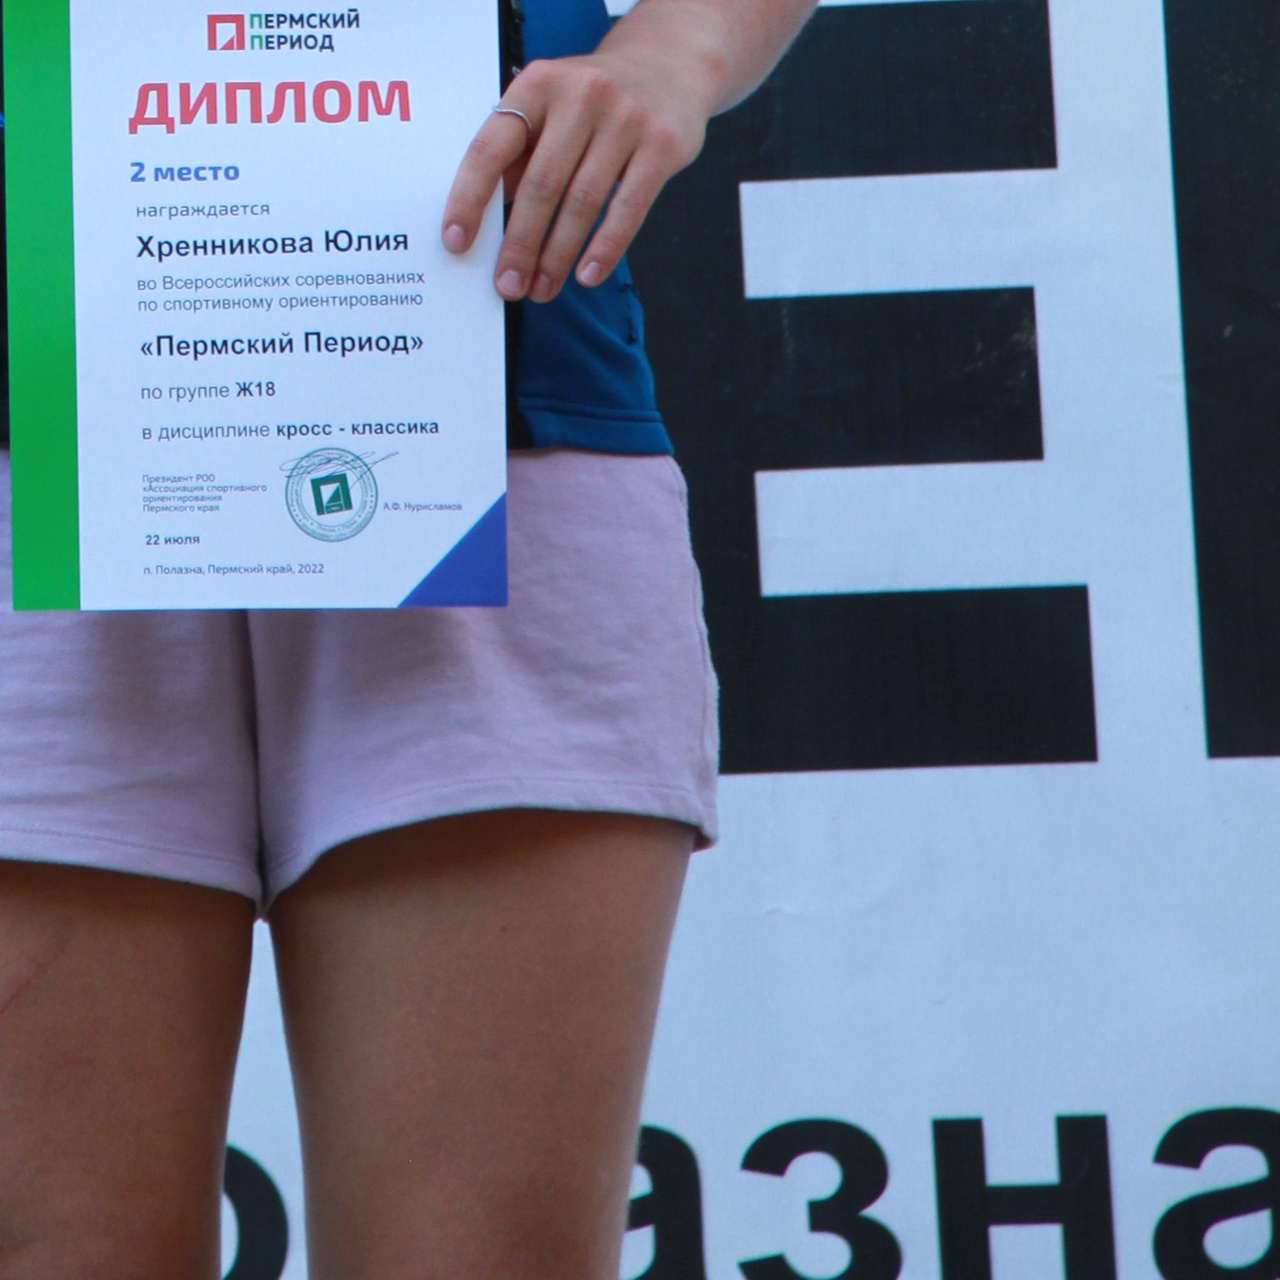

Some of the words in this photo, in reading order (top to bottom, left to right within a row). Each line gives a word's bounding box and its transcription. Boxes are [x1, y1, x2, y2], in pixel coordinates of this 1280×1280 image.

[249, 7, 360, 29] ПЕРМСКИЙ
[249, 33, 335, 53] ПЕРИОД
[128, 80, 411, 135] ДИПЛОМ
[130, 161, 146, 183] 2
[153, 165, 240, 182] место
[136, 204, 270, 221] награждается
[136, 235, 313, 263] Хренникова
[324, 229, 408, 253] Юлия
[136, 279, 157, 291] во
[162, 273, 290, 292] Всероссийских
[295, 272, 425, 288] соревнованиях
[137, 300, 158, 312] по
[163, 297, 274, 313] спортивному
[278, 293, 423, 311] ориентированию
[140, 332, 294, 361] «Пермский
[304, 331, 423, 358] Период»
[140, 386, 163, 400] по
[168, 385, 230, 403] группе
[235, 380, 276, 397] Ж18
[142, 427, 152, 440] в
[158, 424, 270, 441] дисциплине
[276, 423, 332, 440] кросс
[351, 421, 439, 435] классика
[142, 474, 194, 485] Президент
[196, 474, 216, 483] РОО
[206, 484, 267, 494] спортивного
[142, 494, 223, 504] ориентирования
[142, 504, 195, 514] Пермского
[197, 505, 220, 514] края
[145, 534, 160, 546] 22
[163, 535, 200, 545] июля
[155, 565, 205, 576] Полазна,
[208, 564, 264, 577] Пермский
[266, 564, 295, 576] край,
[297, 563, 325, 574] 2022
